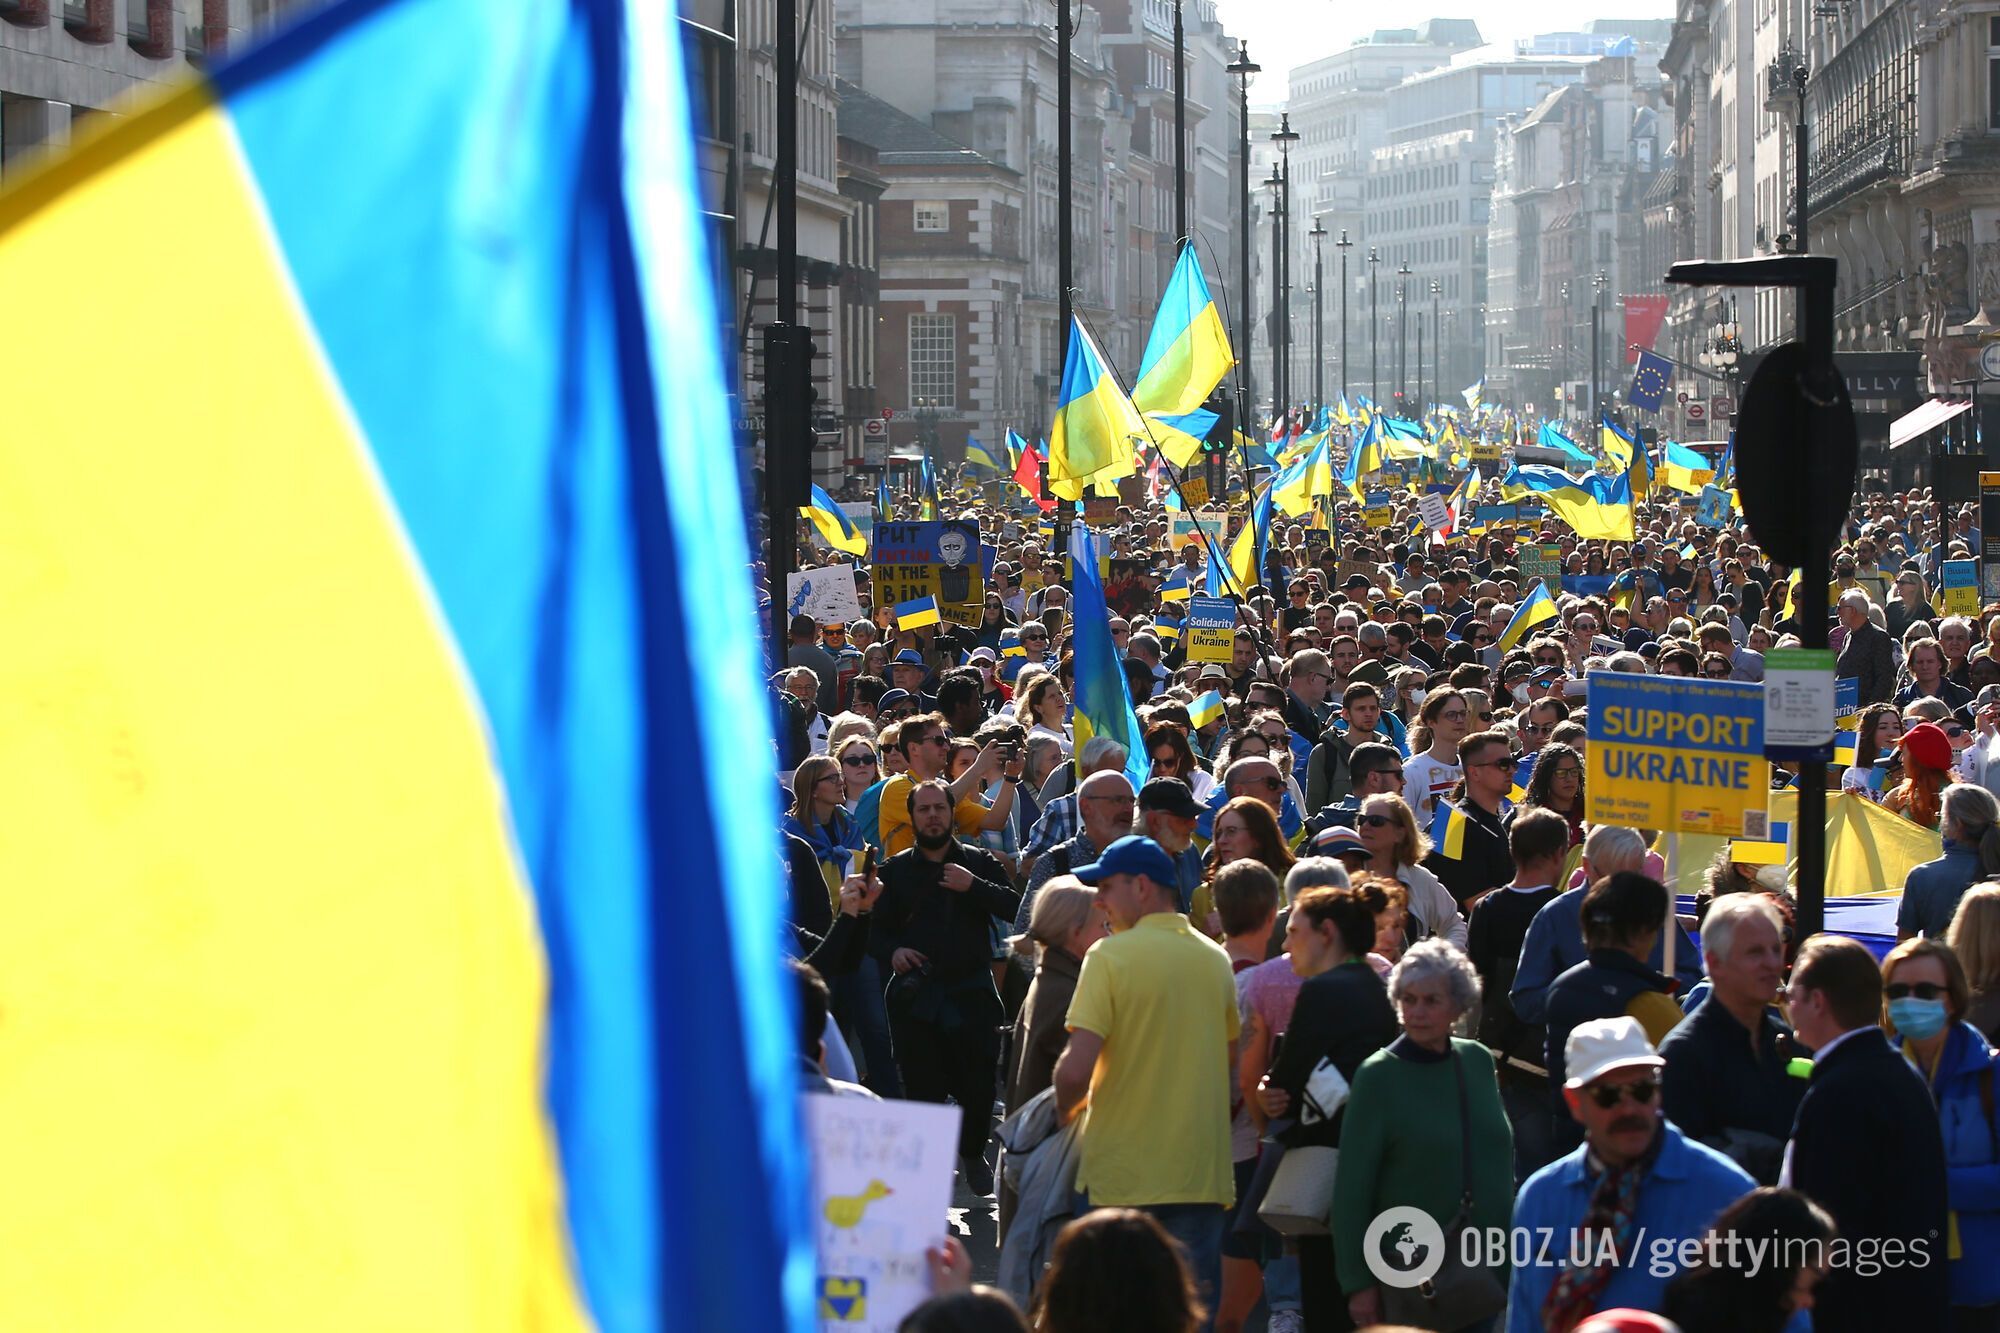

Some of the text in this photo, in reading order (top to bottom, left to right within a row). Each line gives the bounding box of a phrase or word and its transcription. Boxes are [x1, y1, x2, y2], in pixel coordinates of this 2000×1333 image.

[1847, 377, 1902, 391] ILLY
[879, 525, 920, 544] PUT
[898, 565, 930, 580] THE
[1190, 616, 1235, 629] Solidarity
[1193, 635, 1230, 648] Ukraine
[1835, 703, 1857, 717] arity
[1603, 705, 1756, 747] SUPPORT
[1604, 749, 1749, 790] UKRAINE
[1595, 796, 1615, 808] Help
